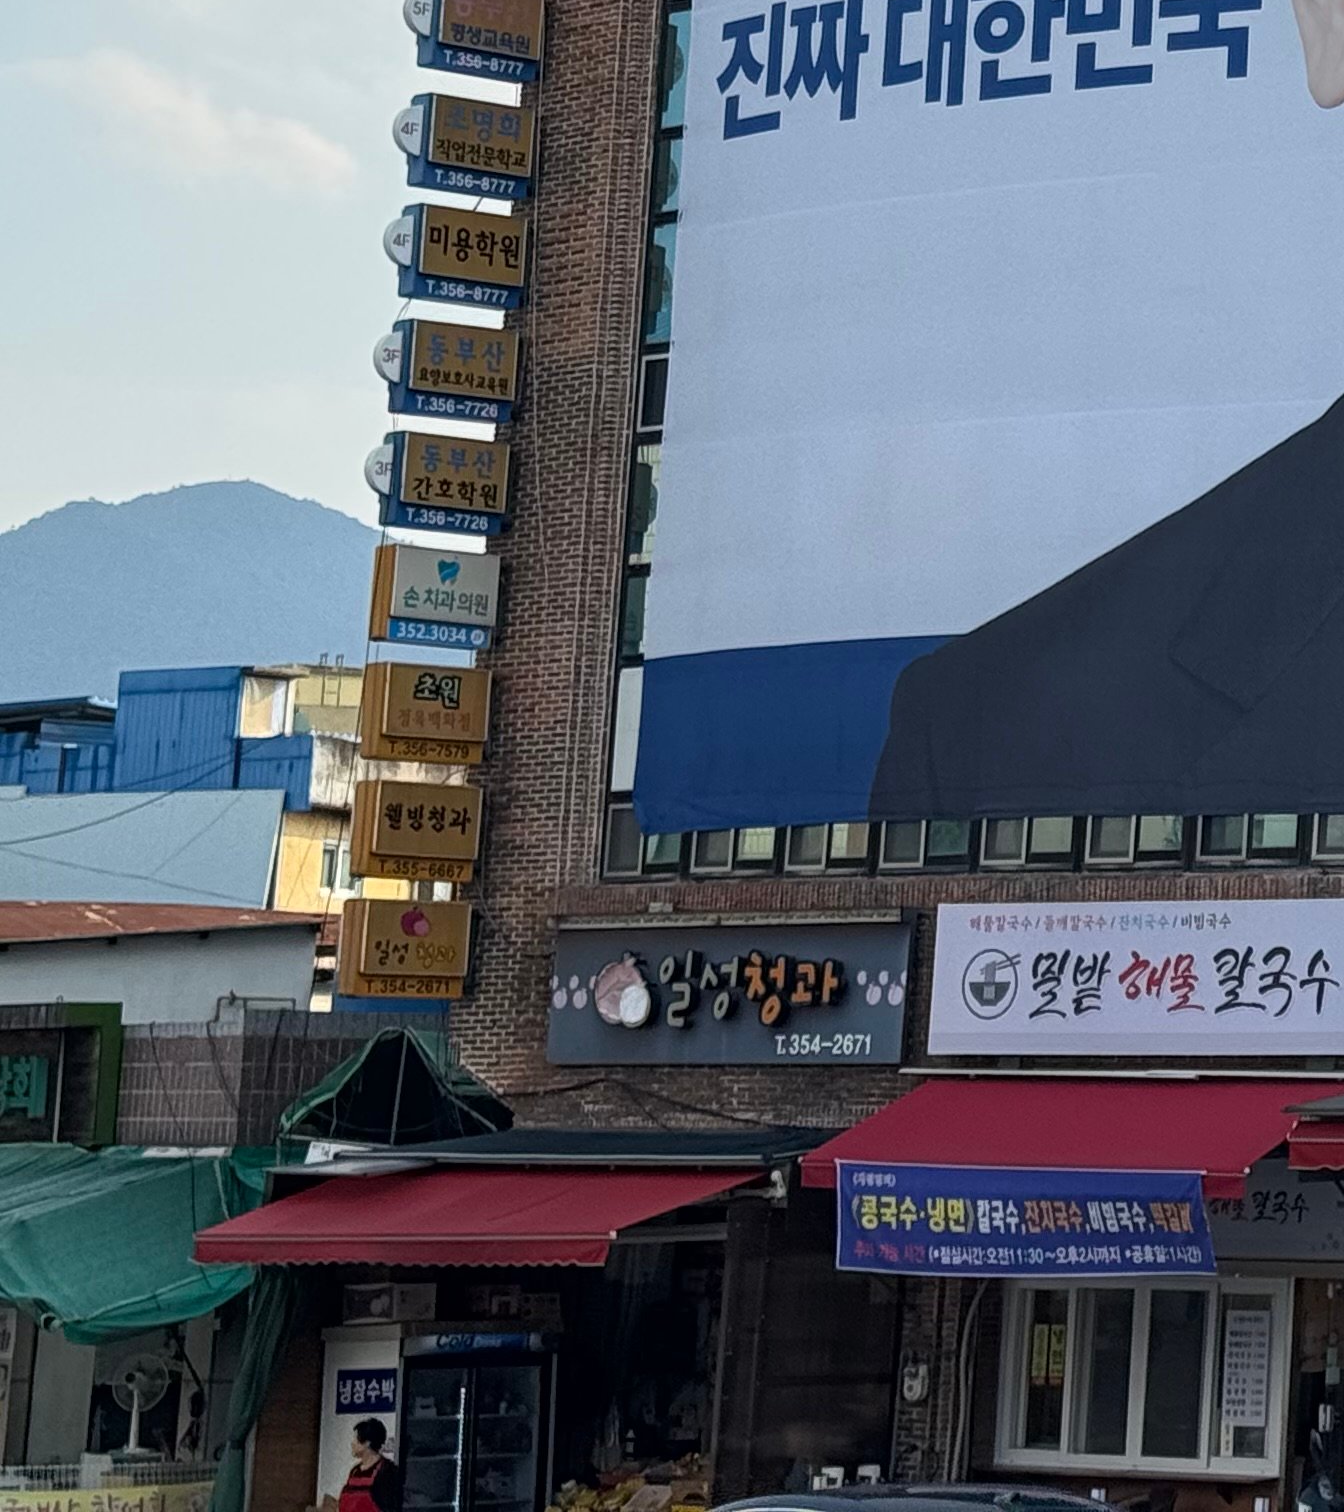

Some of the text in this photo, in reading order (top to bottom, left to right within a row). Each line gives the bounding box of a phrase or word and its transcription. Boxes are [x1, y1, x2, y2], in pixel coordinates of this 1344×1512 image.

[412, 1, 431, 16] 5F
[400, 121, 419, 136] 4F
[436, 138, 528, 170] 직업전문학교
[434, 169, 516, 194] T.356-8777
[428, 224, 521, 269] 미용학원
[425, 279, 509, 305] T.356-8777
[382, 333, 506, 372] 3F 동부산
[415, 394, 499, 418] T.356-7726
[421, 444, 496, 479] 동부산
[413, 476, 499, 509] 간호학원
[406, 506, 489, 531] T.356-7726
[396, 621, 467, 643] 352.3034
[413, 672, 462, 709] 초원
[388, 739, 470, 761] T.356-7579
[1180, 912, 1233, 931] 비빔국수
[1028, 945, 1342, 1020] 밀밭 해물 칼국수
[338, 1376, 396, 1405] 냉장수박
